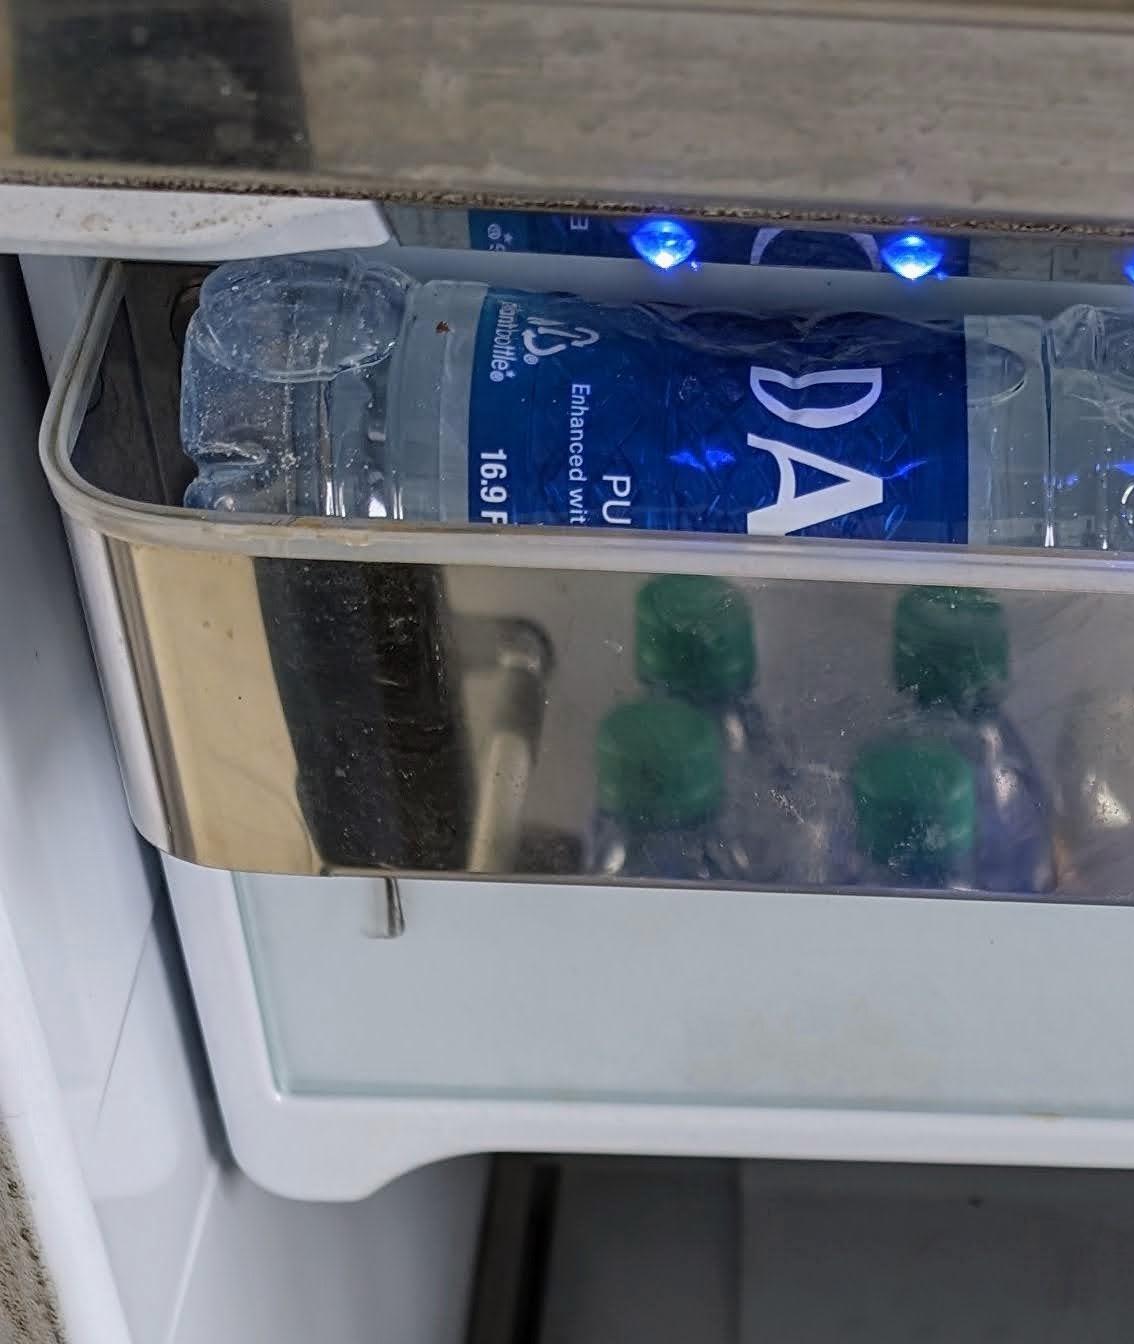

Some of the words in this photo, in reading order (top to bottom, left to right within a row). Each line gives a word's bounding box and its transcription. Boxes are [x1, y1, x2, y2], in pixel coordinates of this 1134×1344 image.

[570, 383, 592, 482] Enhanced
[748, 366, 883, 536] DA
[480, 449, 508, 503] 16.9
[601, 474, 632, 525] PU
